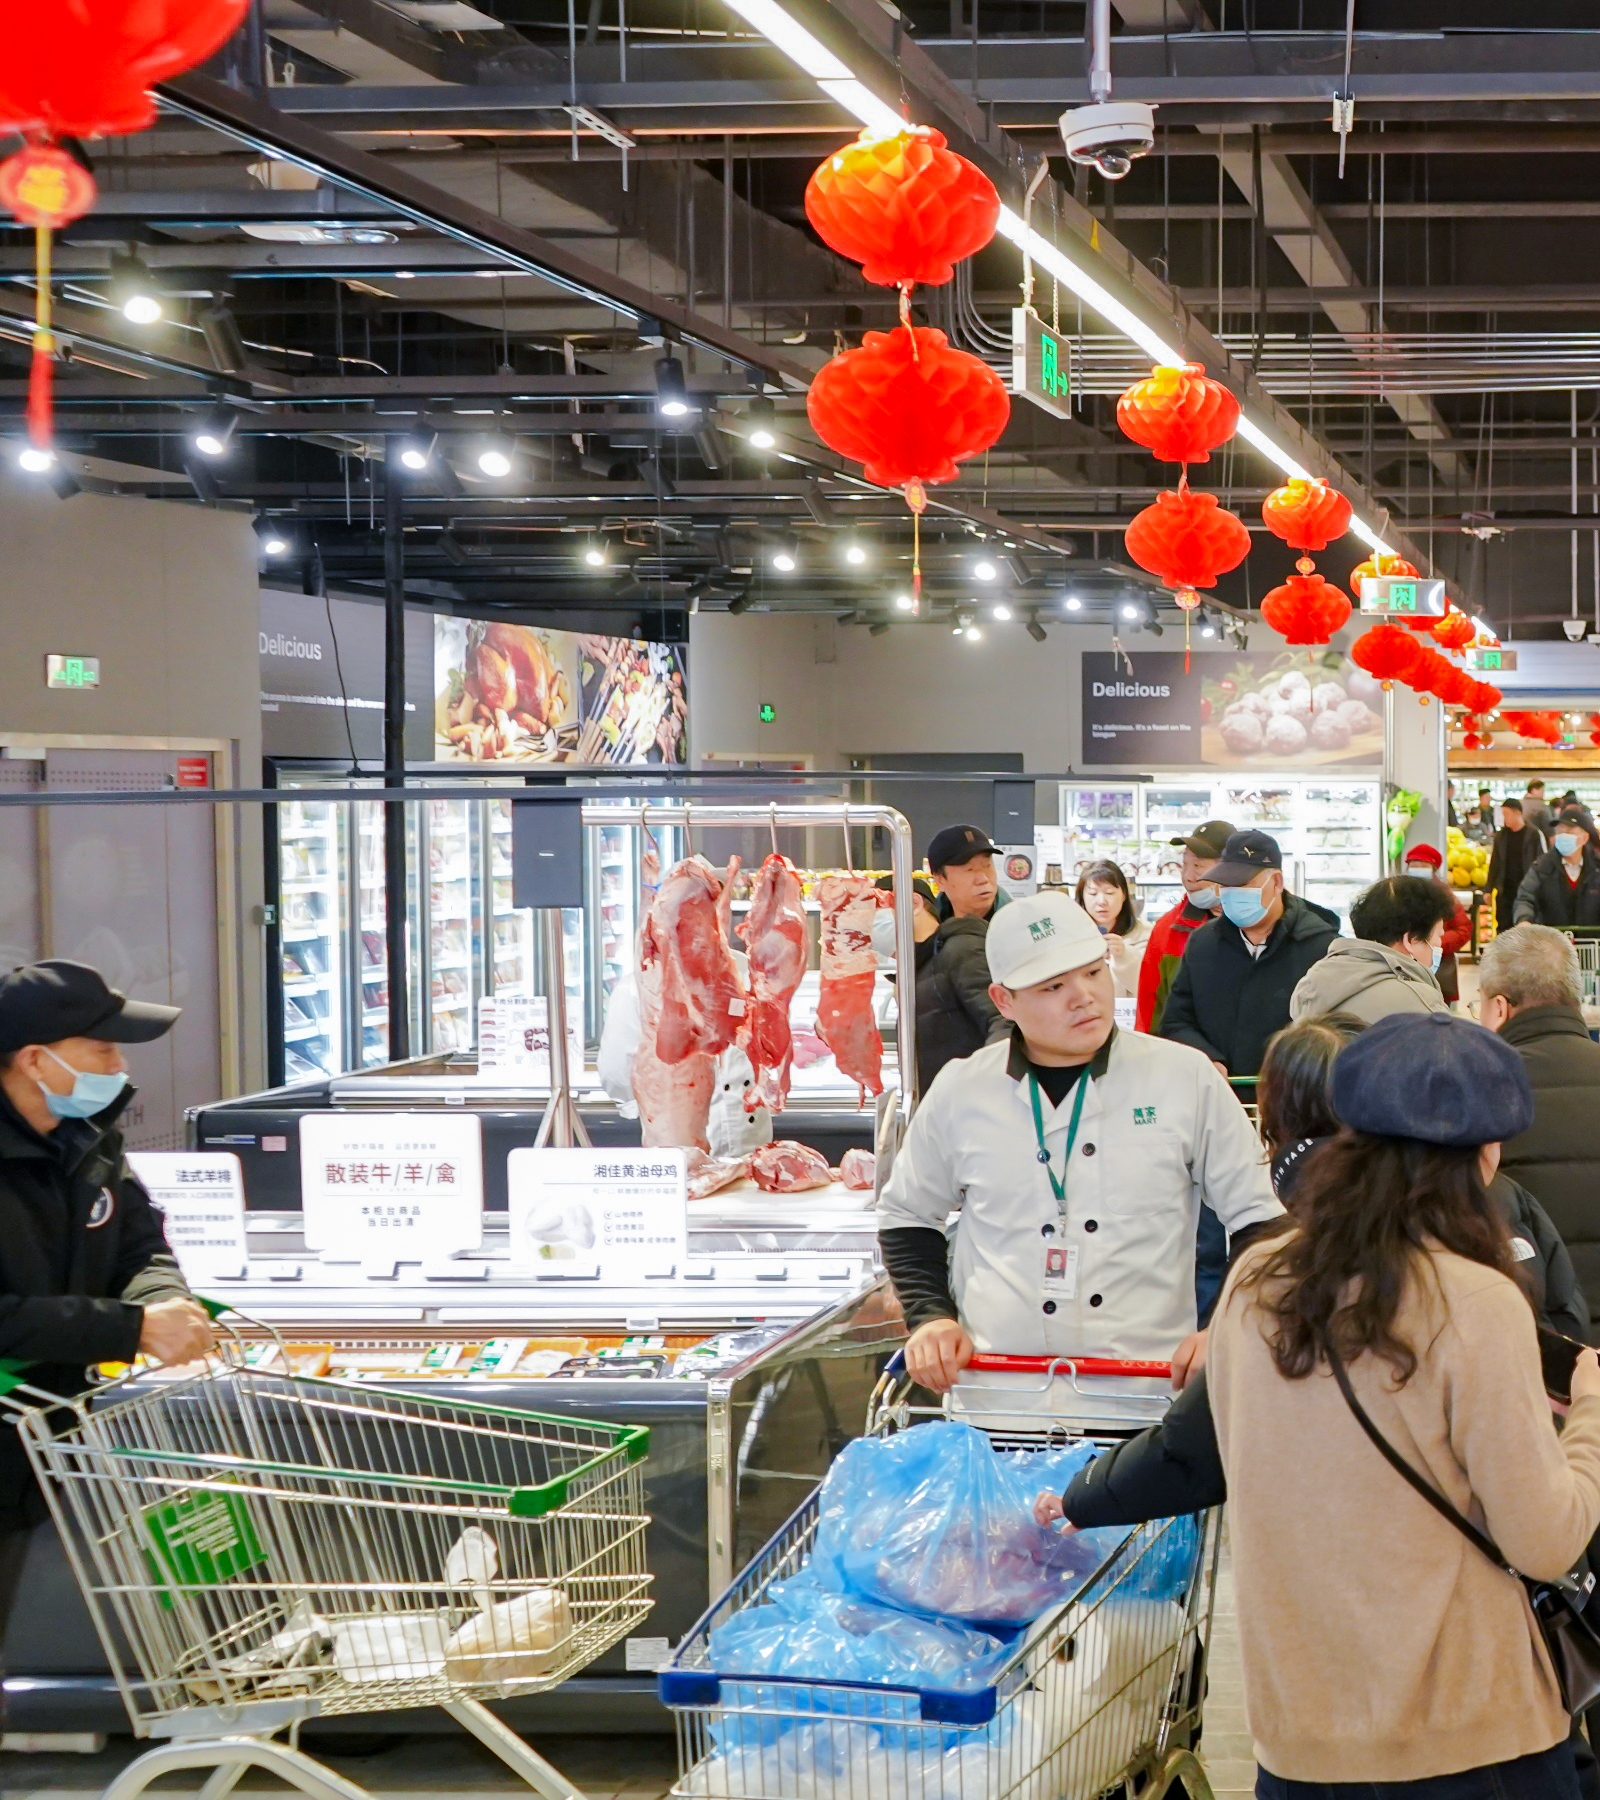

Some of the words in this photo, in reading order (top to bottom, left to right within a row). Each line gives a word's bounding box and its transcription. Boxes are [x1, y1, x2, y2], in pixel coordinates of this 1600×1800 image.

[259, 632, 322, 660] Delicious
[1092, 682, 1170, 698] Delicious
[1032, 928, 1056, 943] MART
[1134, 1117, 1157, 1126] MART
[176, 1169, 231, 1183] 法式羊排
[325, 1162, 456, 1187] 散装牛/羊/禽
[593, 1164, 678, 1179] 湘佳黄油母鸡
[361, 1205, 421, 1216] 本柜台商品
[368, 1217, 414, 1227] 当日出清
